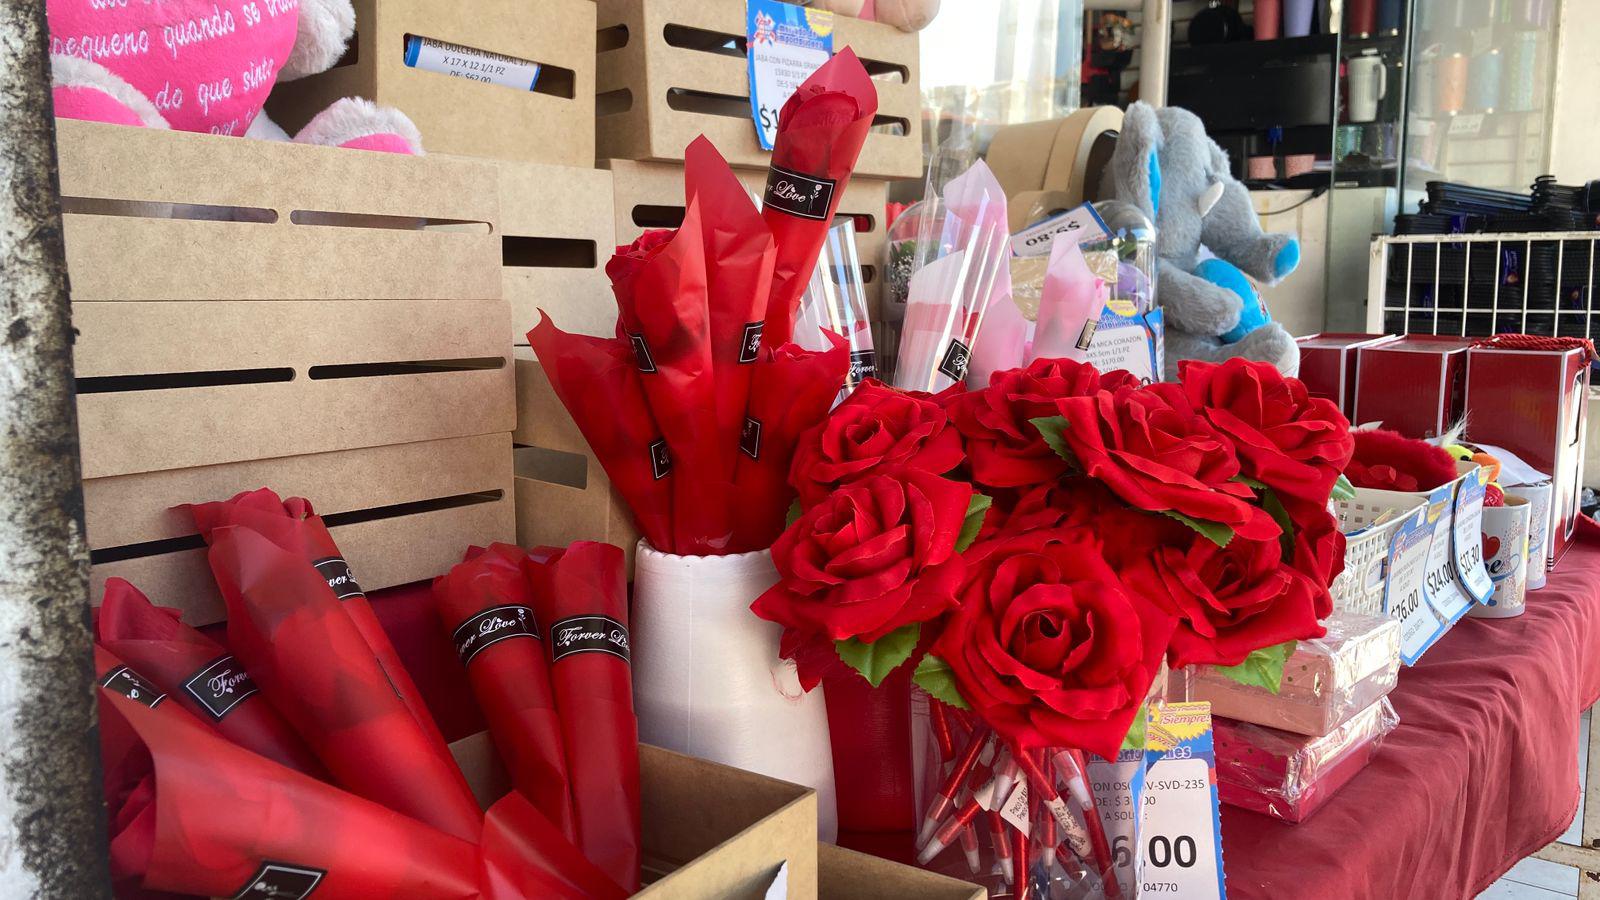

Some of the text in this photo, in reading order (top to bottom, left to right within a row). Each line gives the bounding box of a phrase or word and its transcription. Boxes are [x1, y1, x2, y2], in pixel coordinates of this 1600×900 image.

[163, 5, 235, 58] quando
[242, 2, 261, 27] se
[442, 56, 506, 76] X 17 X 12 1/1 PZ
[155, 81, 183, 110] do
[197, 77, 232, 116] que
[243, 56, 275, 91] sinto
[773, 180, 806, 203] Love
[1427, 560, 1454, 598] $24.00
[478, 616, 516, 638] Love
[557, 625, 606, 647] Forver
[1092, 780, 1112, 792] ON
[1144, 779, 1205, 791] V-SVD-235
[1104, 812, 1112, 821] A
